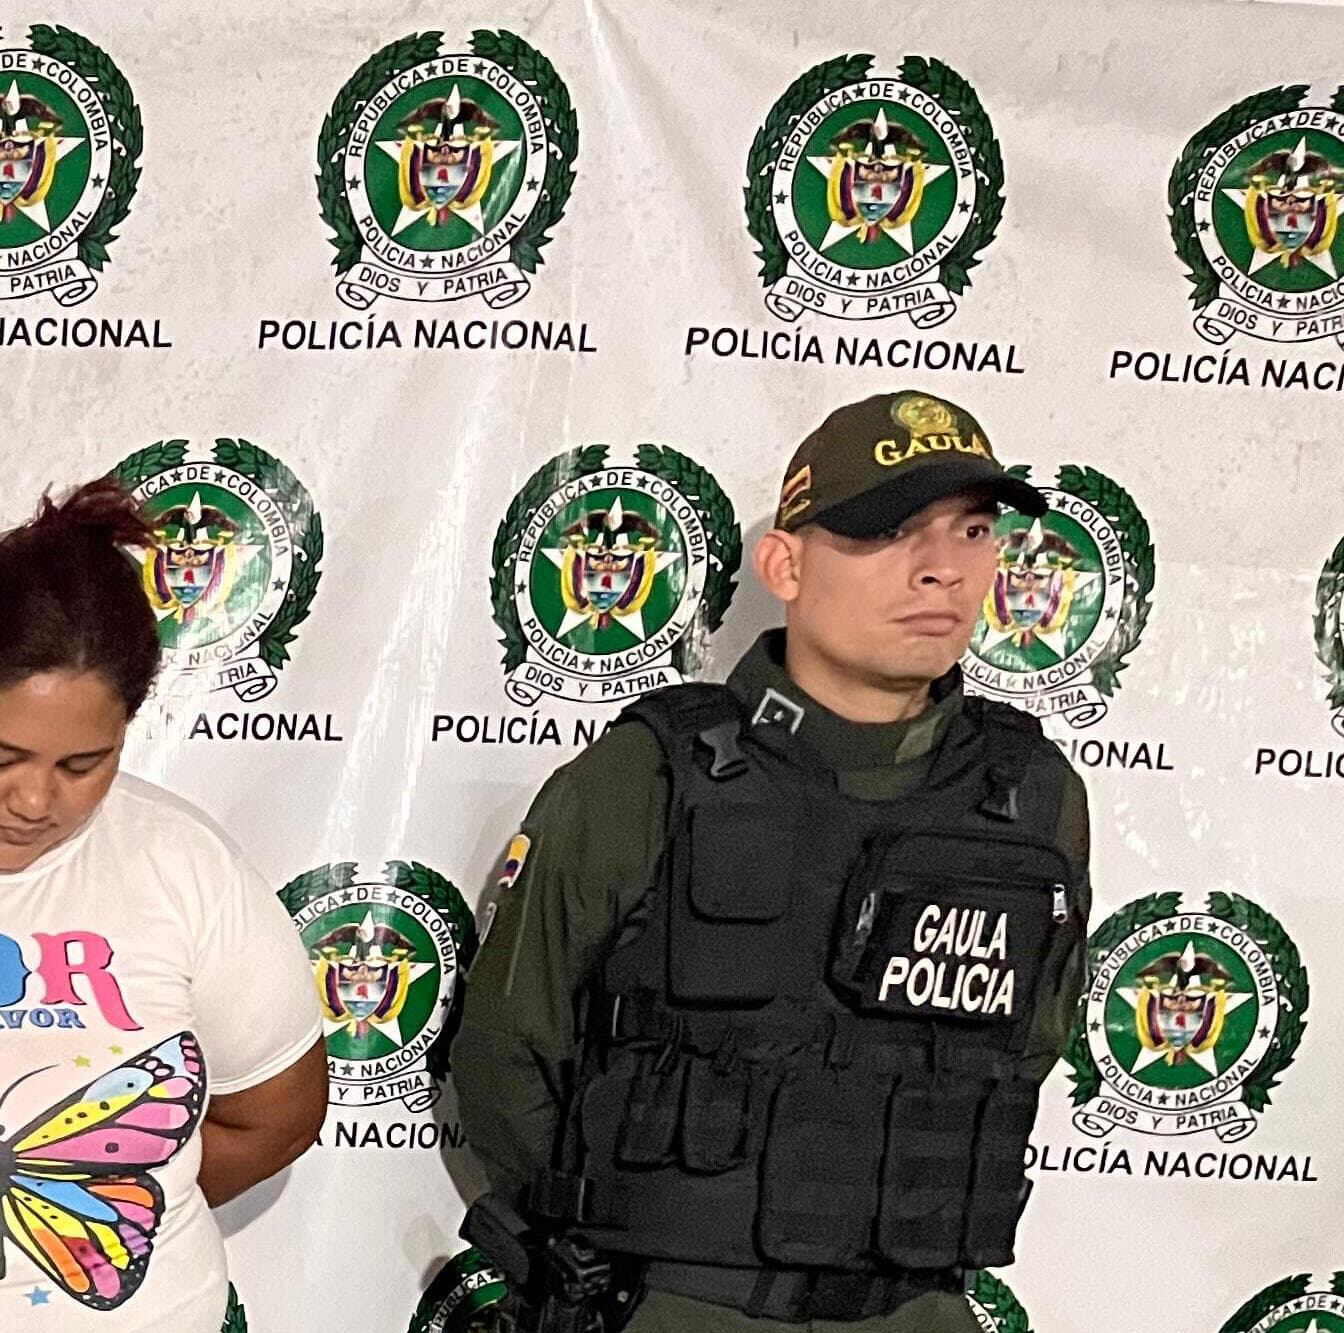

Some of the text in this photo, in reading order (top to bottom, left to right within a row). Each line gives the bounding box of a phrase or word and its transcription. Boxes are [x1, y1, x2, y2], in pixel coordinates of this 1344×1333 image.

[2, 53, 26, 68] DE
[47, 59, 108, 151] COLOMBIA
[780, 82, 972, 179] REPUBLICA DE COLOMBIA
[8, 209, 92, 267] NACIONAL
[12, 264, 76, 293] PATRIA
[785, 231, 957, 288] POLICIA NACIONAL
[786, 281, 935, 313] DIOS Y PATRIA
[259, 314, 597, 352] POLICÍA NACIONAL
[685, 326, 1024, 373] POLICÍA NACIONAL
[1110, 349, 1250, 385] POLICÍA
[874, 433, 991, 466] GAULA
[182, 711, 342, 742] ACIONAL
[432, 710, 561, 745] POLICÍA
[914, 904, 1007, 960] GAULA
[878, 956, 1014, 1015] POLICIA
[1023, 1141, 1317, 1181] OLICÍA NACIONAL
